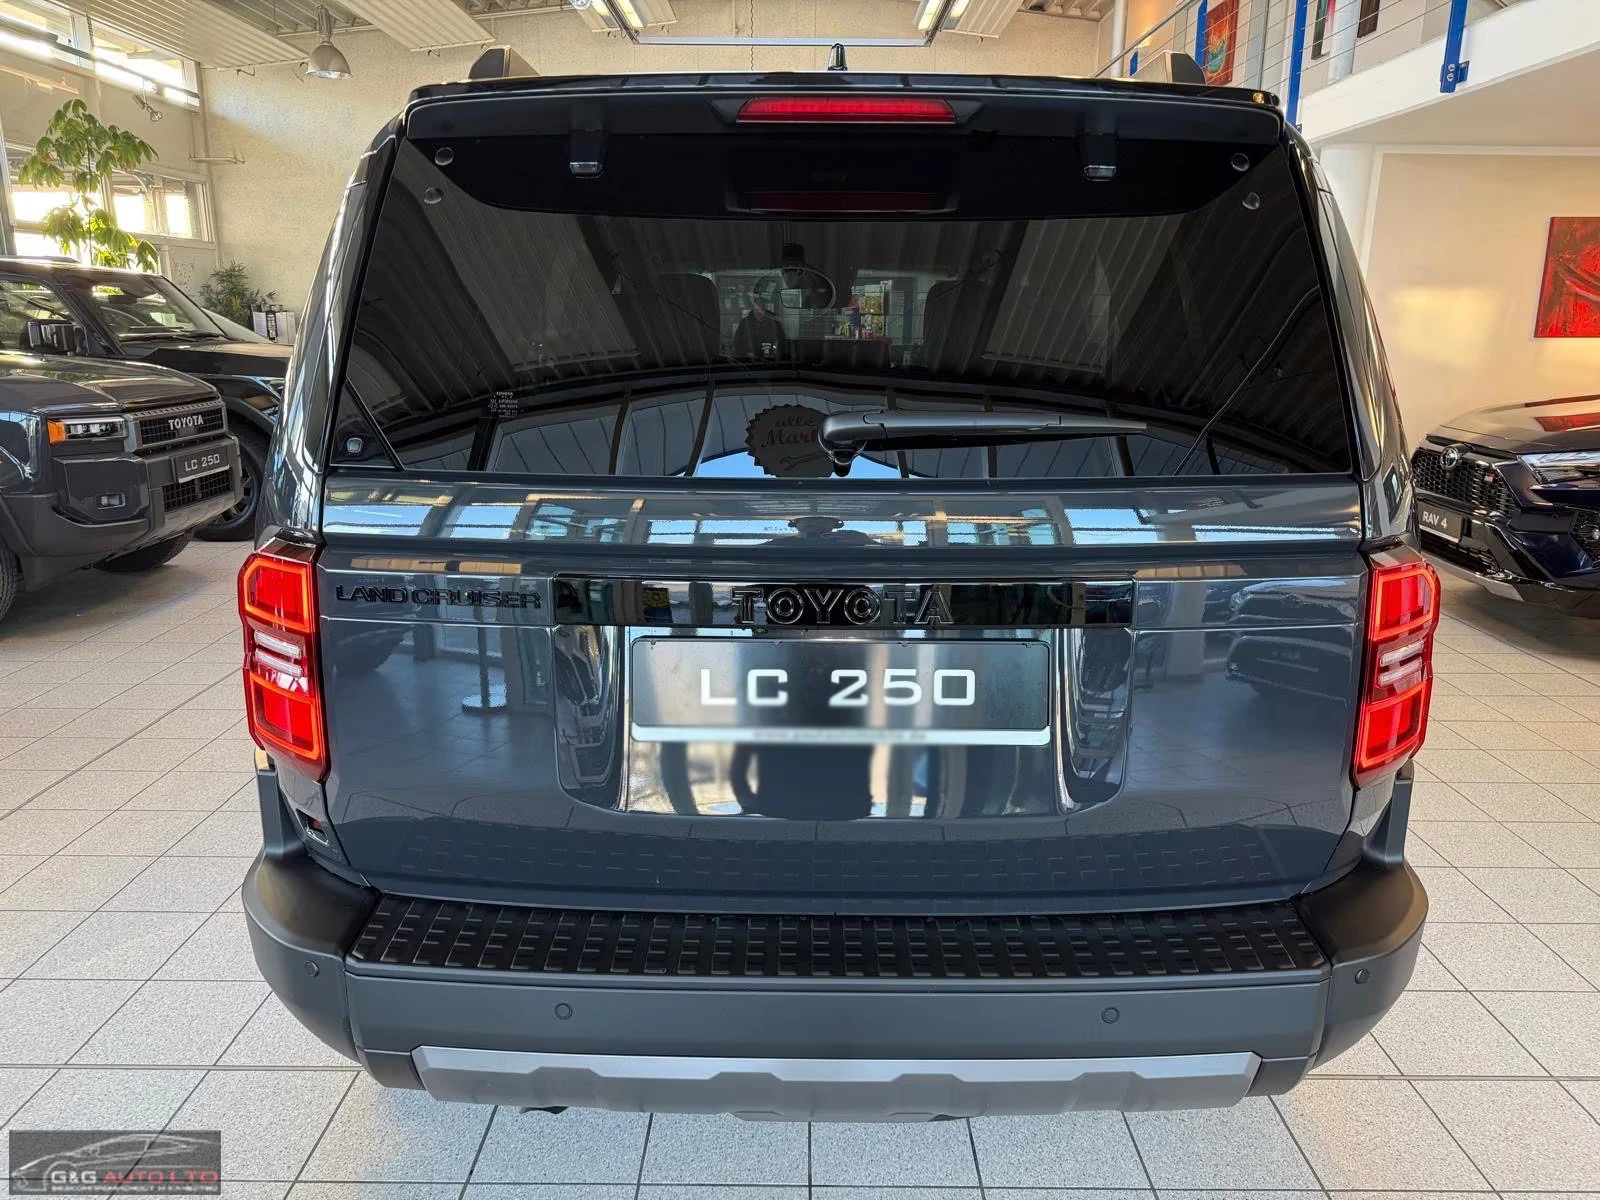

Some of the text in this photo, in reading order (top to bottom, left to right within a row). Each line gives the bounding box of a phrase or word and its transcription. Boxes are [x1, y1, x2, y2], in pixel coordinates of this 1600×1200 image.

[168, 415, 204, 430] TOYOTA
[185, 454, 220, 471] LC 250
[1423, 511, 1448, 528] RAV 4
[335, 584, 542, 609] LAND CRUISER
[732, 587, 954, 625] TOYOTA
[699, 668, 976, 706] LC 250
